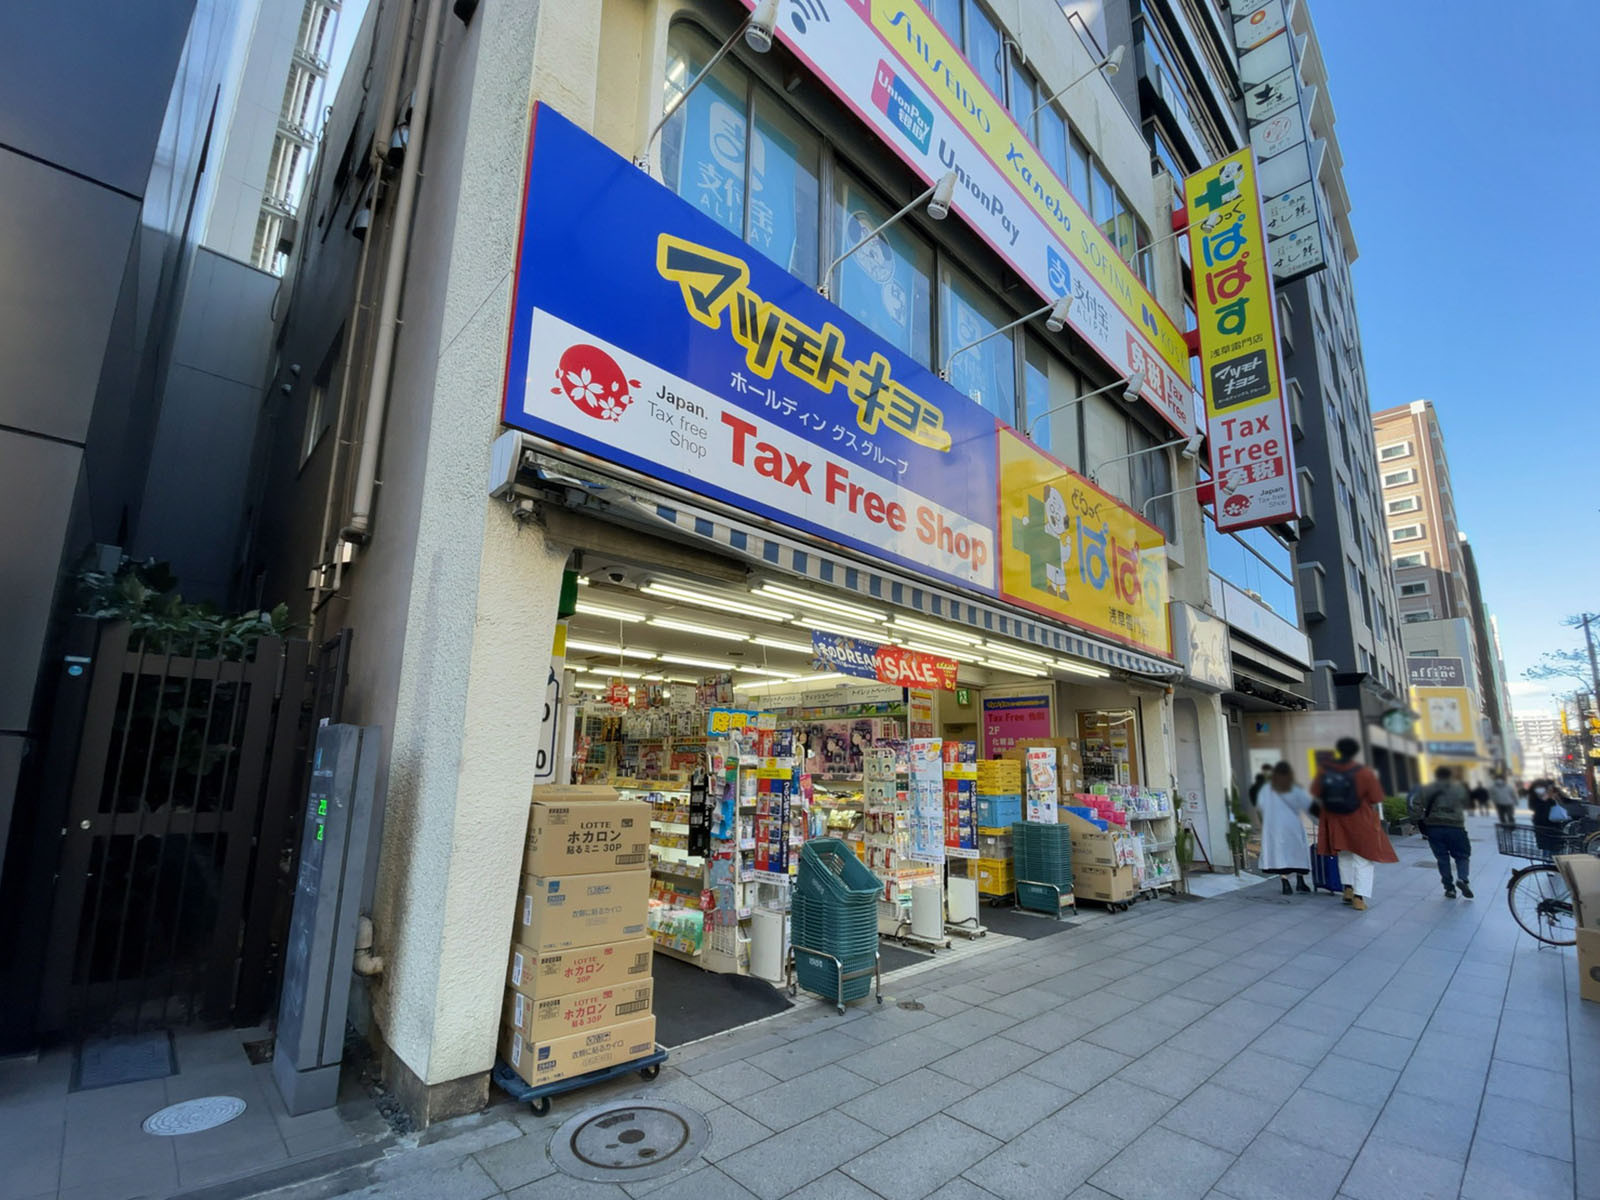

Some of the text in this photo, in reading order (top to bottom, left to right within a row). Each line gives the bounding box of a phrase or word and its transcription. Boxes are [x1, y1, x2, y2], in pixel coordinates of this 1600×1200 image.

[877, 69, 930, 135] UnionPay
[884, 10, 991, 134] SHISEIDO
[1006, 143, 1072, 233] Kanebo
[1081, 230, 1133, 305] SOFINA
[938, 138, 1020, 247] UnionPay
[1202, 213, 1252, 335] ぱぱす
[658, 235, 950, 452] マツモトキヨシ
[1210, 333, 1264, 359] 浅草雷門店
[656, 385, 709, 420] Japan.
[1167, 374, 1185, 406] Tax
[648, 400, 708, 440] Tax free
[1167, 392, 1187, 425] Free
[1221, 414, 1271, 442] Tax
[669, 430, 707, 459] Shop
[1218, 439, 1279, 468] Free
[721, 411, 987, 572] Tax Free Shop
[883, 656, 938, 683] SALE
[1408, 667, 1456, 678] affine
[988, 725, 1000, 736] 2F
[567, 830, 622, 844] ホカロン
[580, 821, 611, 829] LOTTE
[603, 843, 622, 852] 30P
[564, 962, 605, 978] ホカロン
[574, 956, 597, 965] LOTTE
[564, 1003, 607, 1020] ホカロン
[574, 997, 598, 1007] LOTTE
